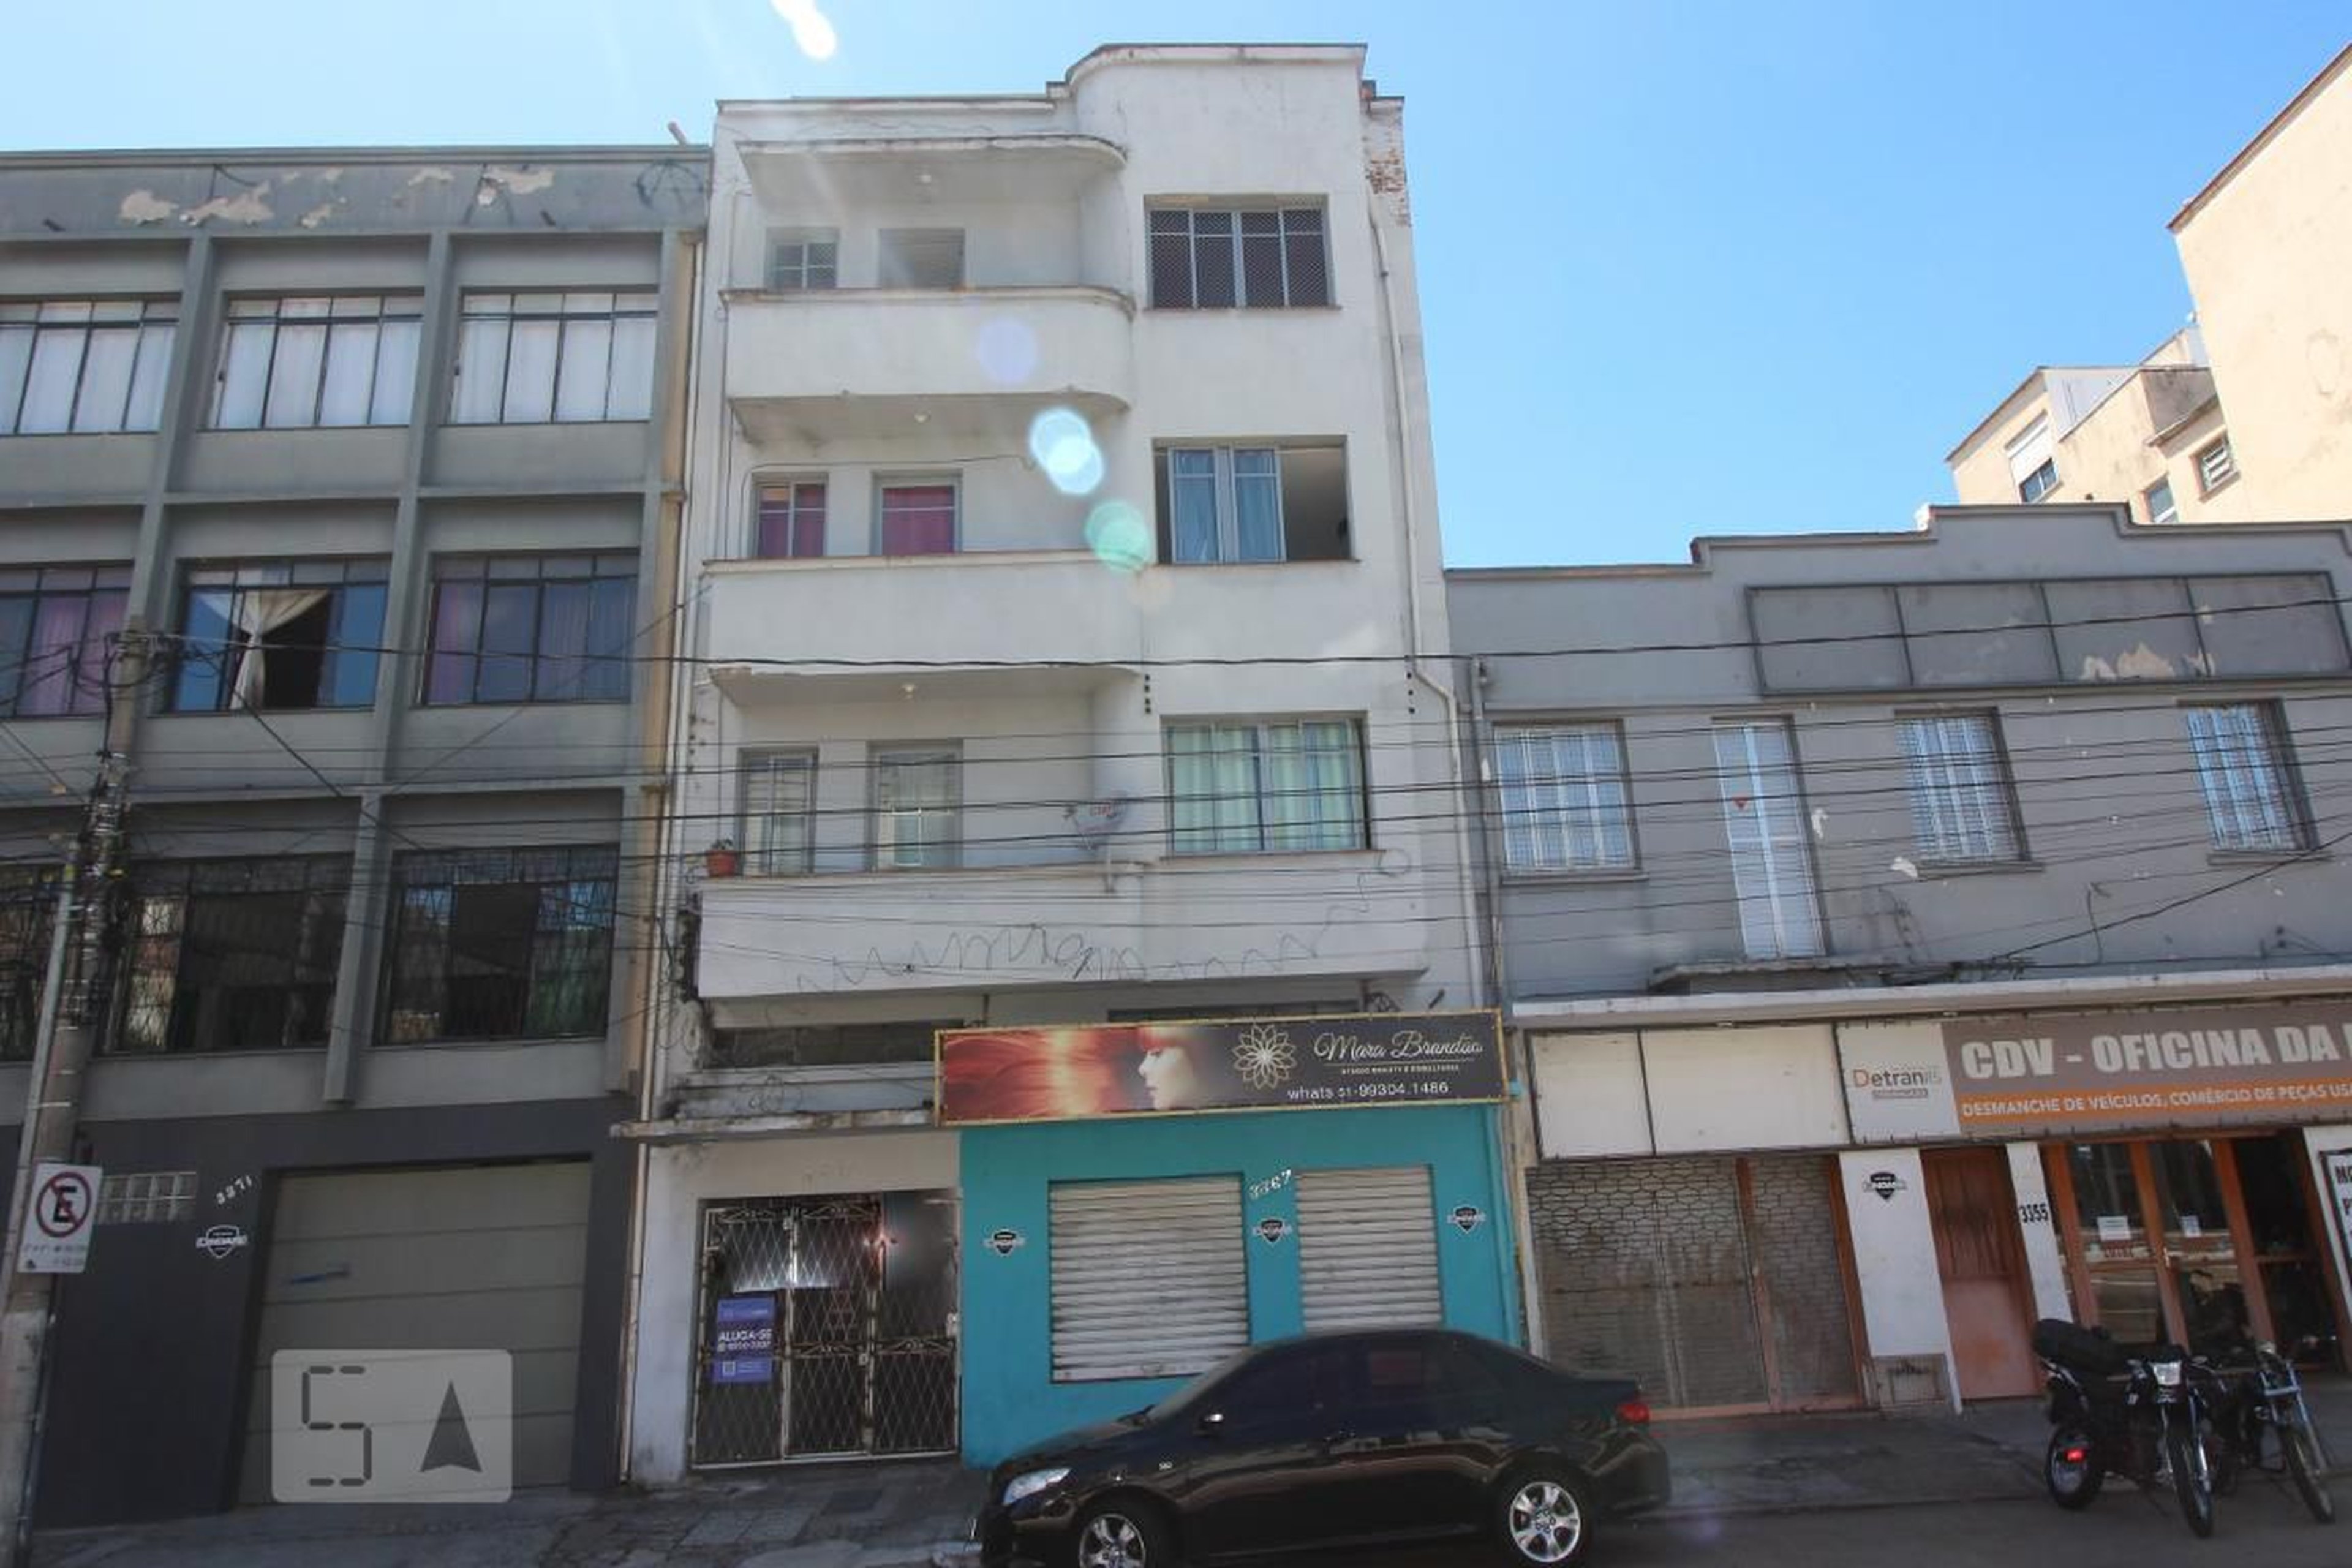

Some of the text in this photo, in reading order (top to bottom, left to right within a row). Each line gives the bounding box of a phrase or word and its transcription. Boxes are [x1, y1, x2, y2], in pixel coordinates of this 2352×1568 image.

[1962, 1039, 2054, 1078] CDV
[2091, 1028, 2271, 1073] OFICINA
[2274, 1025, 2340, 1063] DA
[1287, 1085, 1333, 1100] whats
[1962, 1099, 2061, 1116] DESMANCHE
[2064, 1098, 2085, 1112] DE
[2254, 1087, 2274, 1101] DE
[2278, 1084, 2326, 1102] PEÇAS
[2018, 1203, 2048, 1223] 3355
